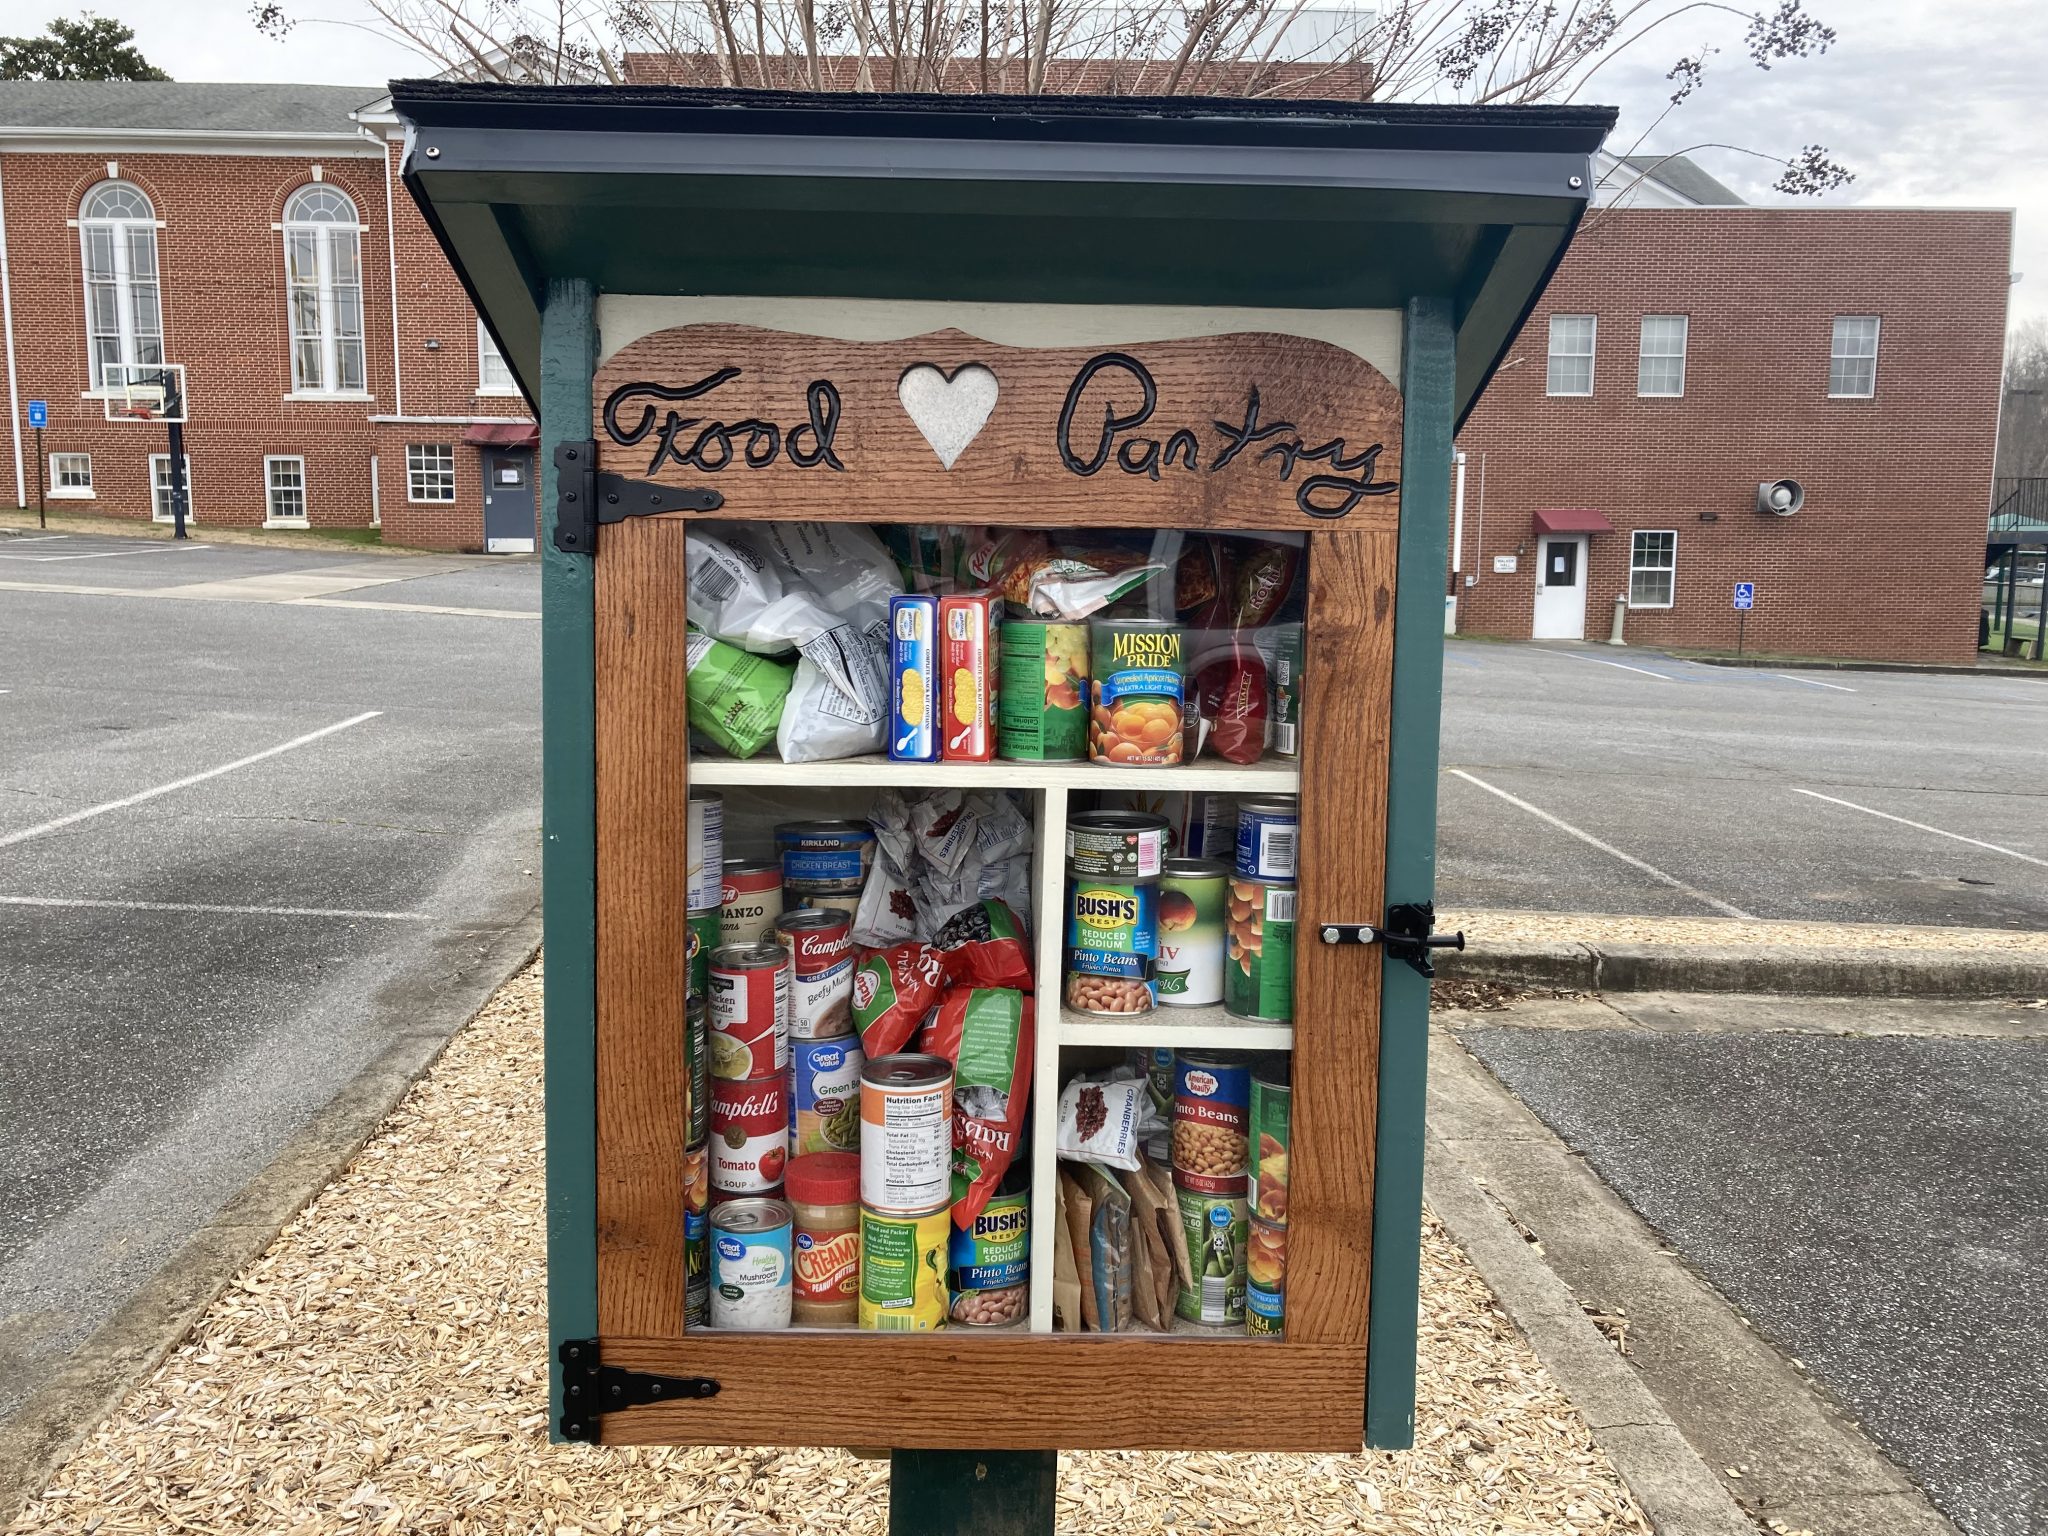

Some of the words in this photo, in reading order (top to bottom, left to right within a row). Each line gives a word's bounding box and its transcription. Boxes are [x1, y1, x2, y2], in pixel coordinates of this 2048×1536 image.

[602, 366, 844, 476] Food
[1060, 352, 1398, 519] Pantry
[708, 543, 735, 568] PRODUCT
[732, 564, 742, 574] OF
[739, 571, 750, 586] USA
[1113, 633, 1181, 662] MISSION
[1126, 653, 1171, 668] PRIDE
[1125, 684, 1144, 692] EXTRA
[1145, 684, 1162, 692] LIGHT
[940, 811, 975, 859] CRANBERRIES
[801, 839, 839, 848] KIRKLAND
[791, 861, 820, 870] CHICKEN
[822, 860, 852, 870] BREAST
[1077, 895, 1135, 920] BUSH'S
[1089, 917, 1117, 925] BEST
[1082, 929, 1127, 940] REDUCED
[1084, 937, 1123, 948] SODIUM
[1074, 949, 1099, 962] Pinto
[1103, 953, 1139, 966] Beans
[1102, 965, 1121, 973] Pintos
[806, 971, 830, 982] GREAT
[807, 985, 832, 1006] Beefy
[812, 1051, 840, 1062] Great
[820, 1060, 840, 1068] Value
[1188, 1071, 1214, 1085] American
[819, 1083, 850, 1096] Green
[1190, 1083, 1211, 1094] Beauty
[924, 1094, 942, 1102] Facts
[710, 1090, 778, 1121] ampbell's
[1198, 1105, 1239, 1124] Beans
[1117, 1088, 1134, 1155] CRANBERRIES
[717, 1156, 756, 1172] Tomato
[975, 1208, 1027, 1236] BUSH'S
[1190, 1218, 1201, 1228] 60
[991, 1231, 1016, 1240] BEST
[719, 1240, 741, 1252] Great
[883, 1238, 906, 1246] Ripeness
[983, 1241, 1023, 1255] REDUCED
[723, 1249, 741, 1258] Value
[798, 1238, 859, 1280] CREAMY
[985, 1250, 1020, 1263] SODIUM
[740, 1270, 778, 1282] Mushroom
[971, 1267, 1002, 1279] Pinto
[736, 1278, 765, 1286] Condensed
[812, 1277, 834, 1293] PEANUT
[842, 1280, 859, 1290] FRES
